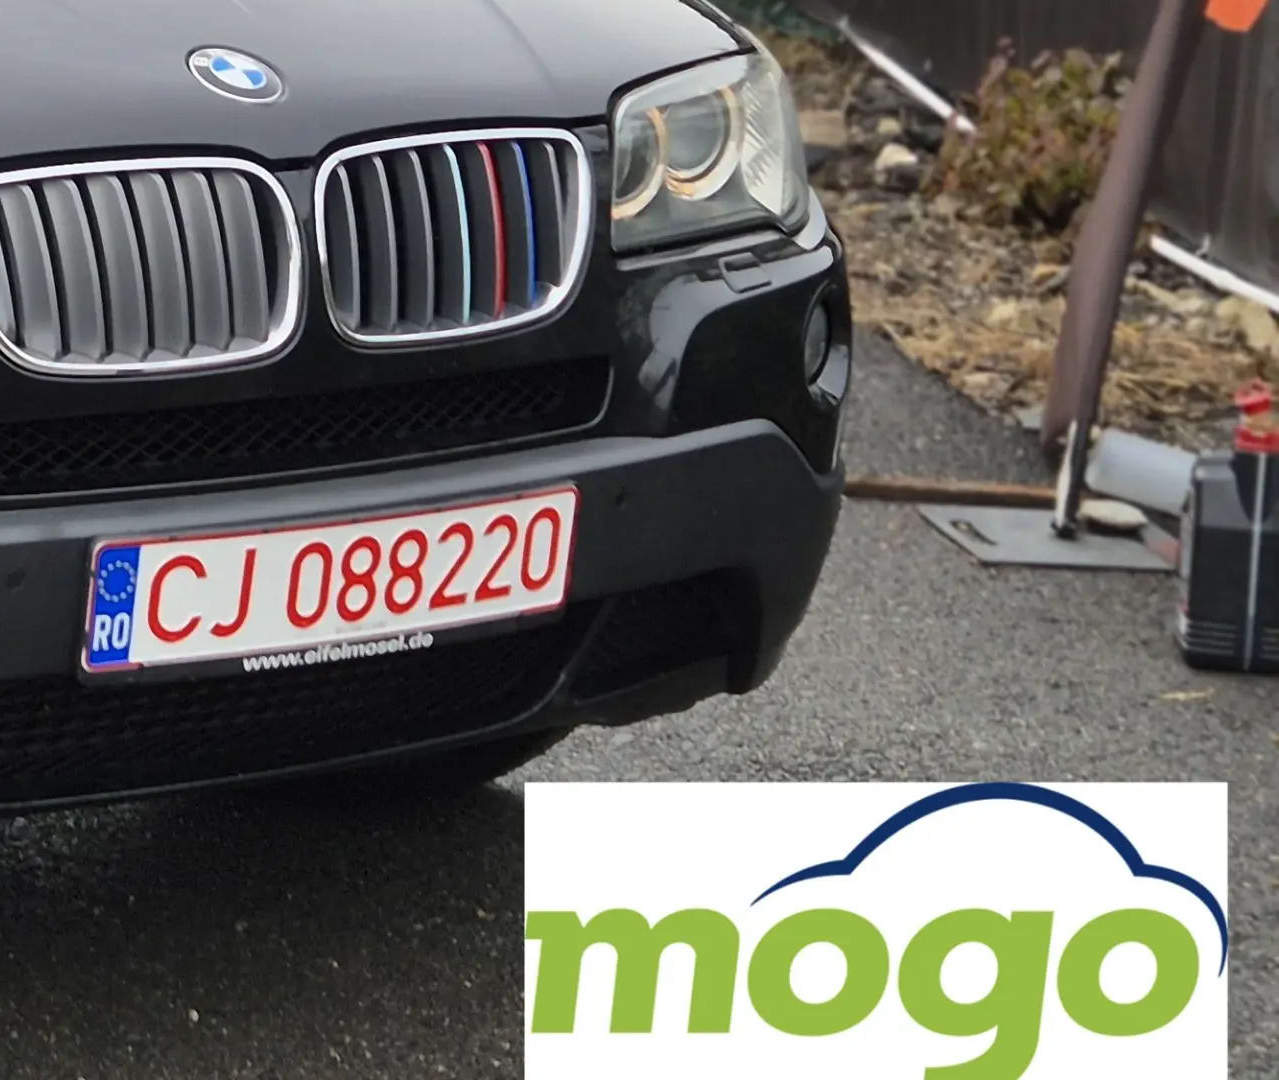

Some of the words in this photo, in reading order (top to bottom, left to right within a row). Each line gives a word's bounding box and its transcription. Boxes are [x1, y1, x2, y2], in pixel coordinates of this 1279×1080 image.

[147, 548, 257, 643] CJ
[286, 507, 562, 630] 088220
[92, 612, 130, 652] RO
[242, 631, 433, 672] www.eifelmosel.de
